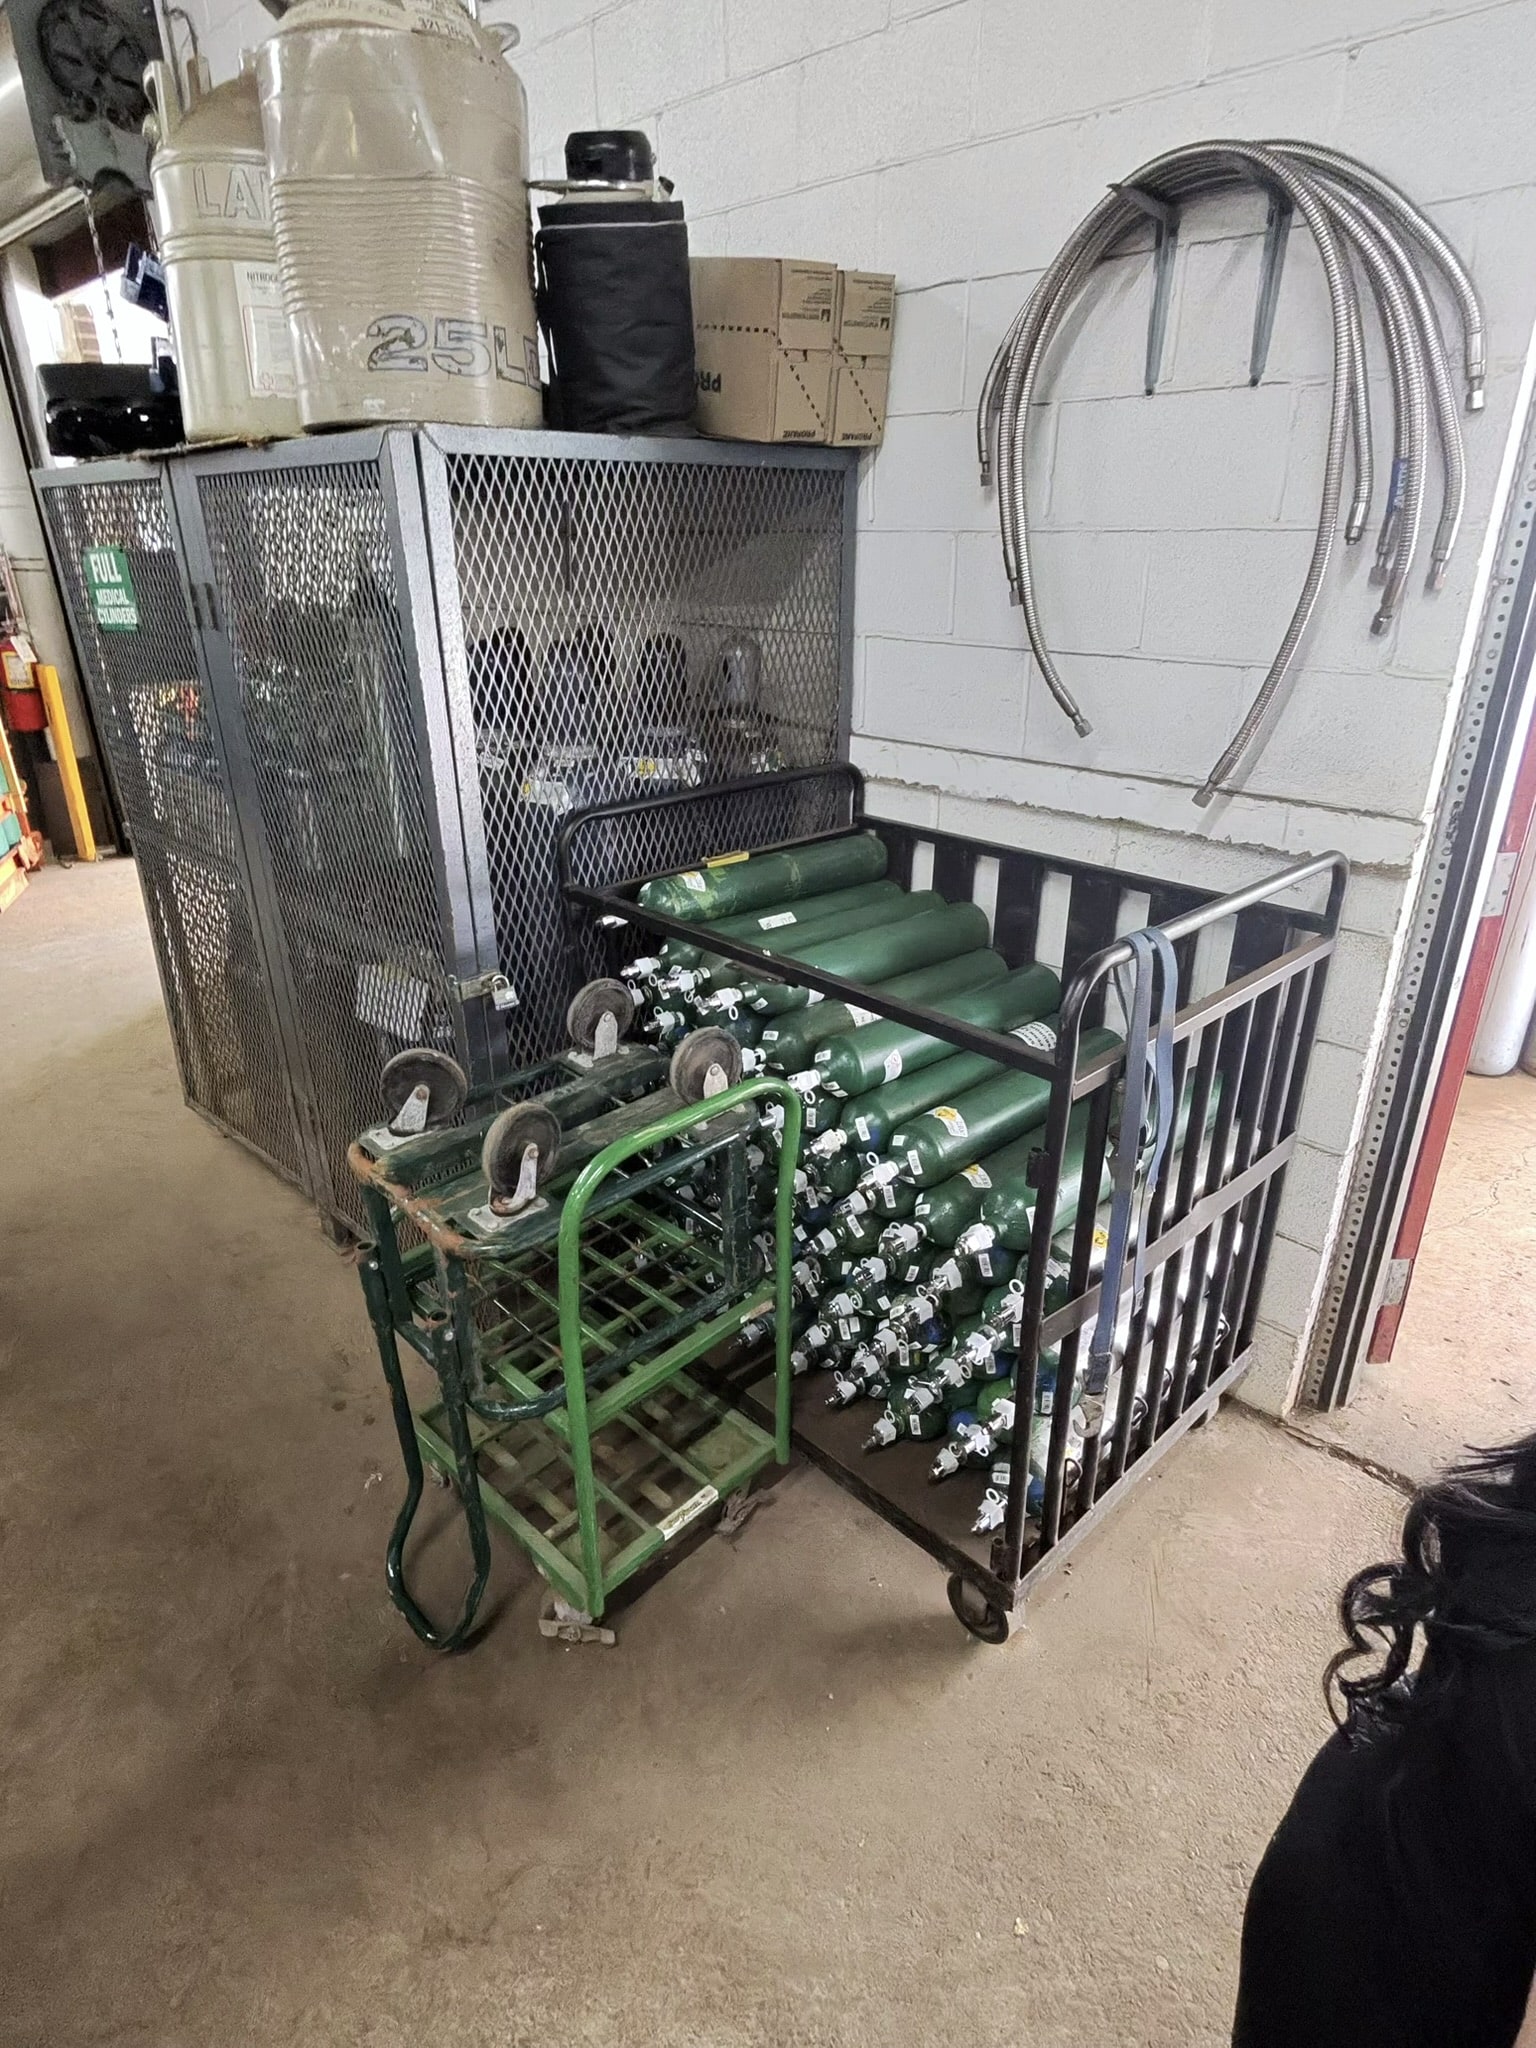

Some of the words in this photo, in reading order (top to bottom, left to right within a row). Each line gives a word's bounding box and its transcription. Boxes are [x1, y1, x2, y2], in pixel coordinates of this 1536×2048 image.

[89, 551, 122, 584] FULL
[95, 588, 130, 605] MEDICAL
[97, 607, 138, 625] CYLINDERS
